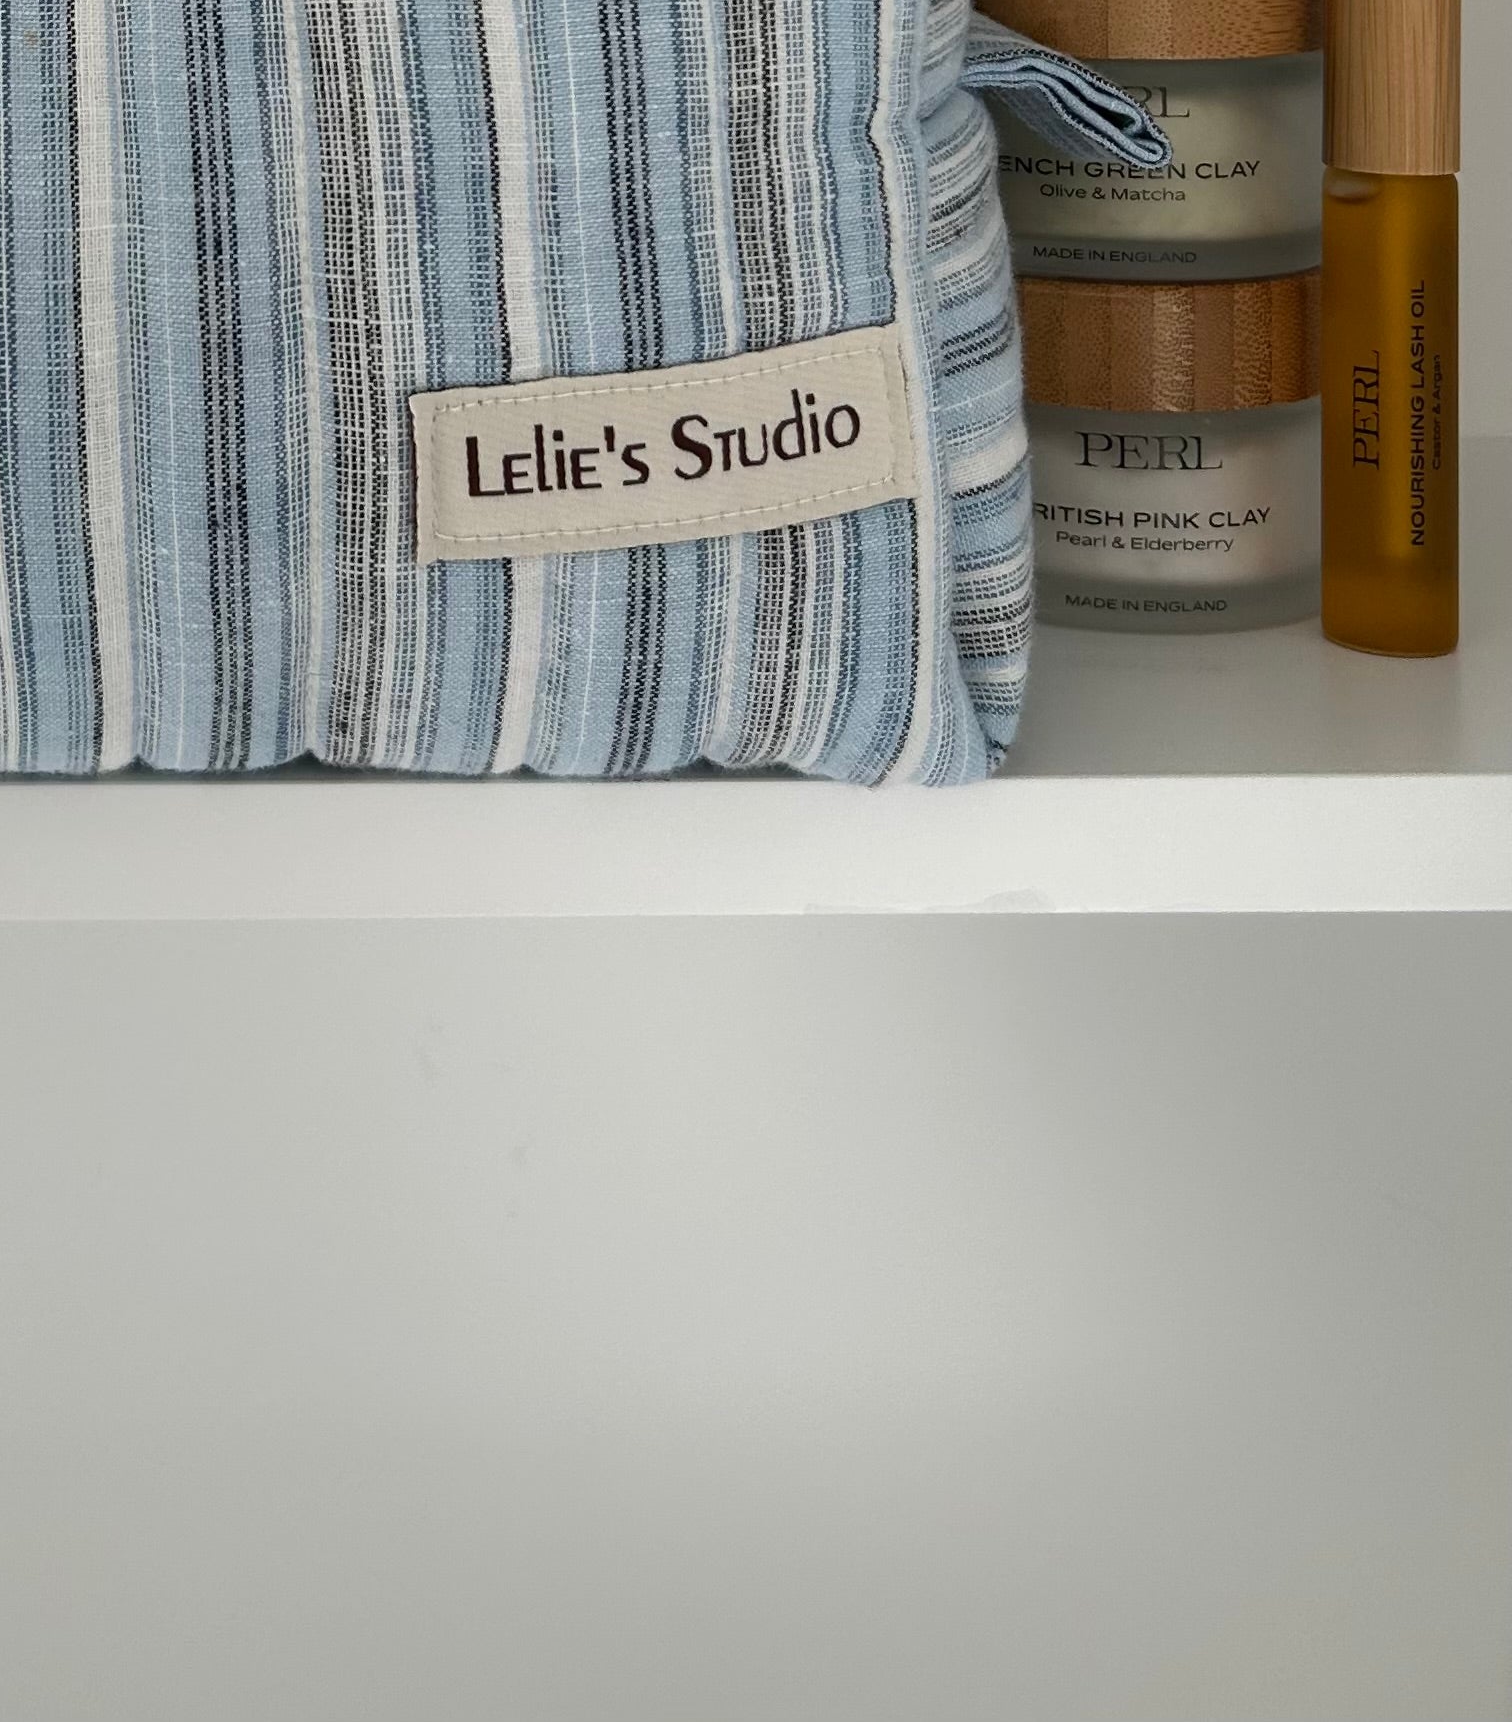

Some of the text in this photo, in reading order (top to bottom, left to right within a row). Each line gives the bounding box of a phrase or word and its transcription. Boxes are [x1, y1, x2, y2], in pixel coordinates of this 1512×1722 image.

[1120, 86, 1190, 118] RL
[999, 155, 1260, 180] ENCH GREEN CLAY
[1040, 183, 1186, 202] Olive & Matcha
[1033, 245, 1198, 263] MADE IN ENGLAND
[1352, 350, 1380, 470] PERL
[1410, 279, 1425, 546] NOURISHING LASH OIL
[1432, 354, 1443, 470] Castor & Argan
[670, 388, 860, 479] Studio
[1074, 430, 1223, 470] PERL
[1033, 502, 1271, 529] RITISH PINK CLAY
[1056, 530, 1234, 552] Pearl & Elderberry
[1065, 594, 1228, 613] MADE IN ENGLAND
